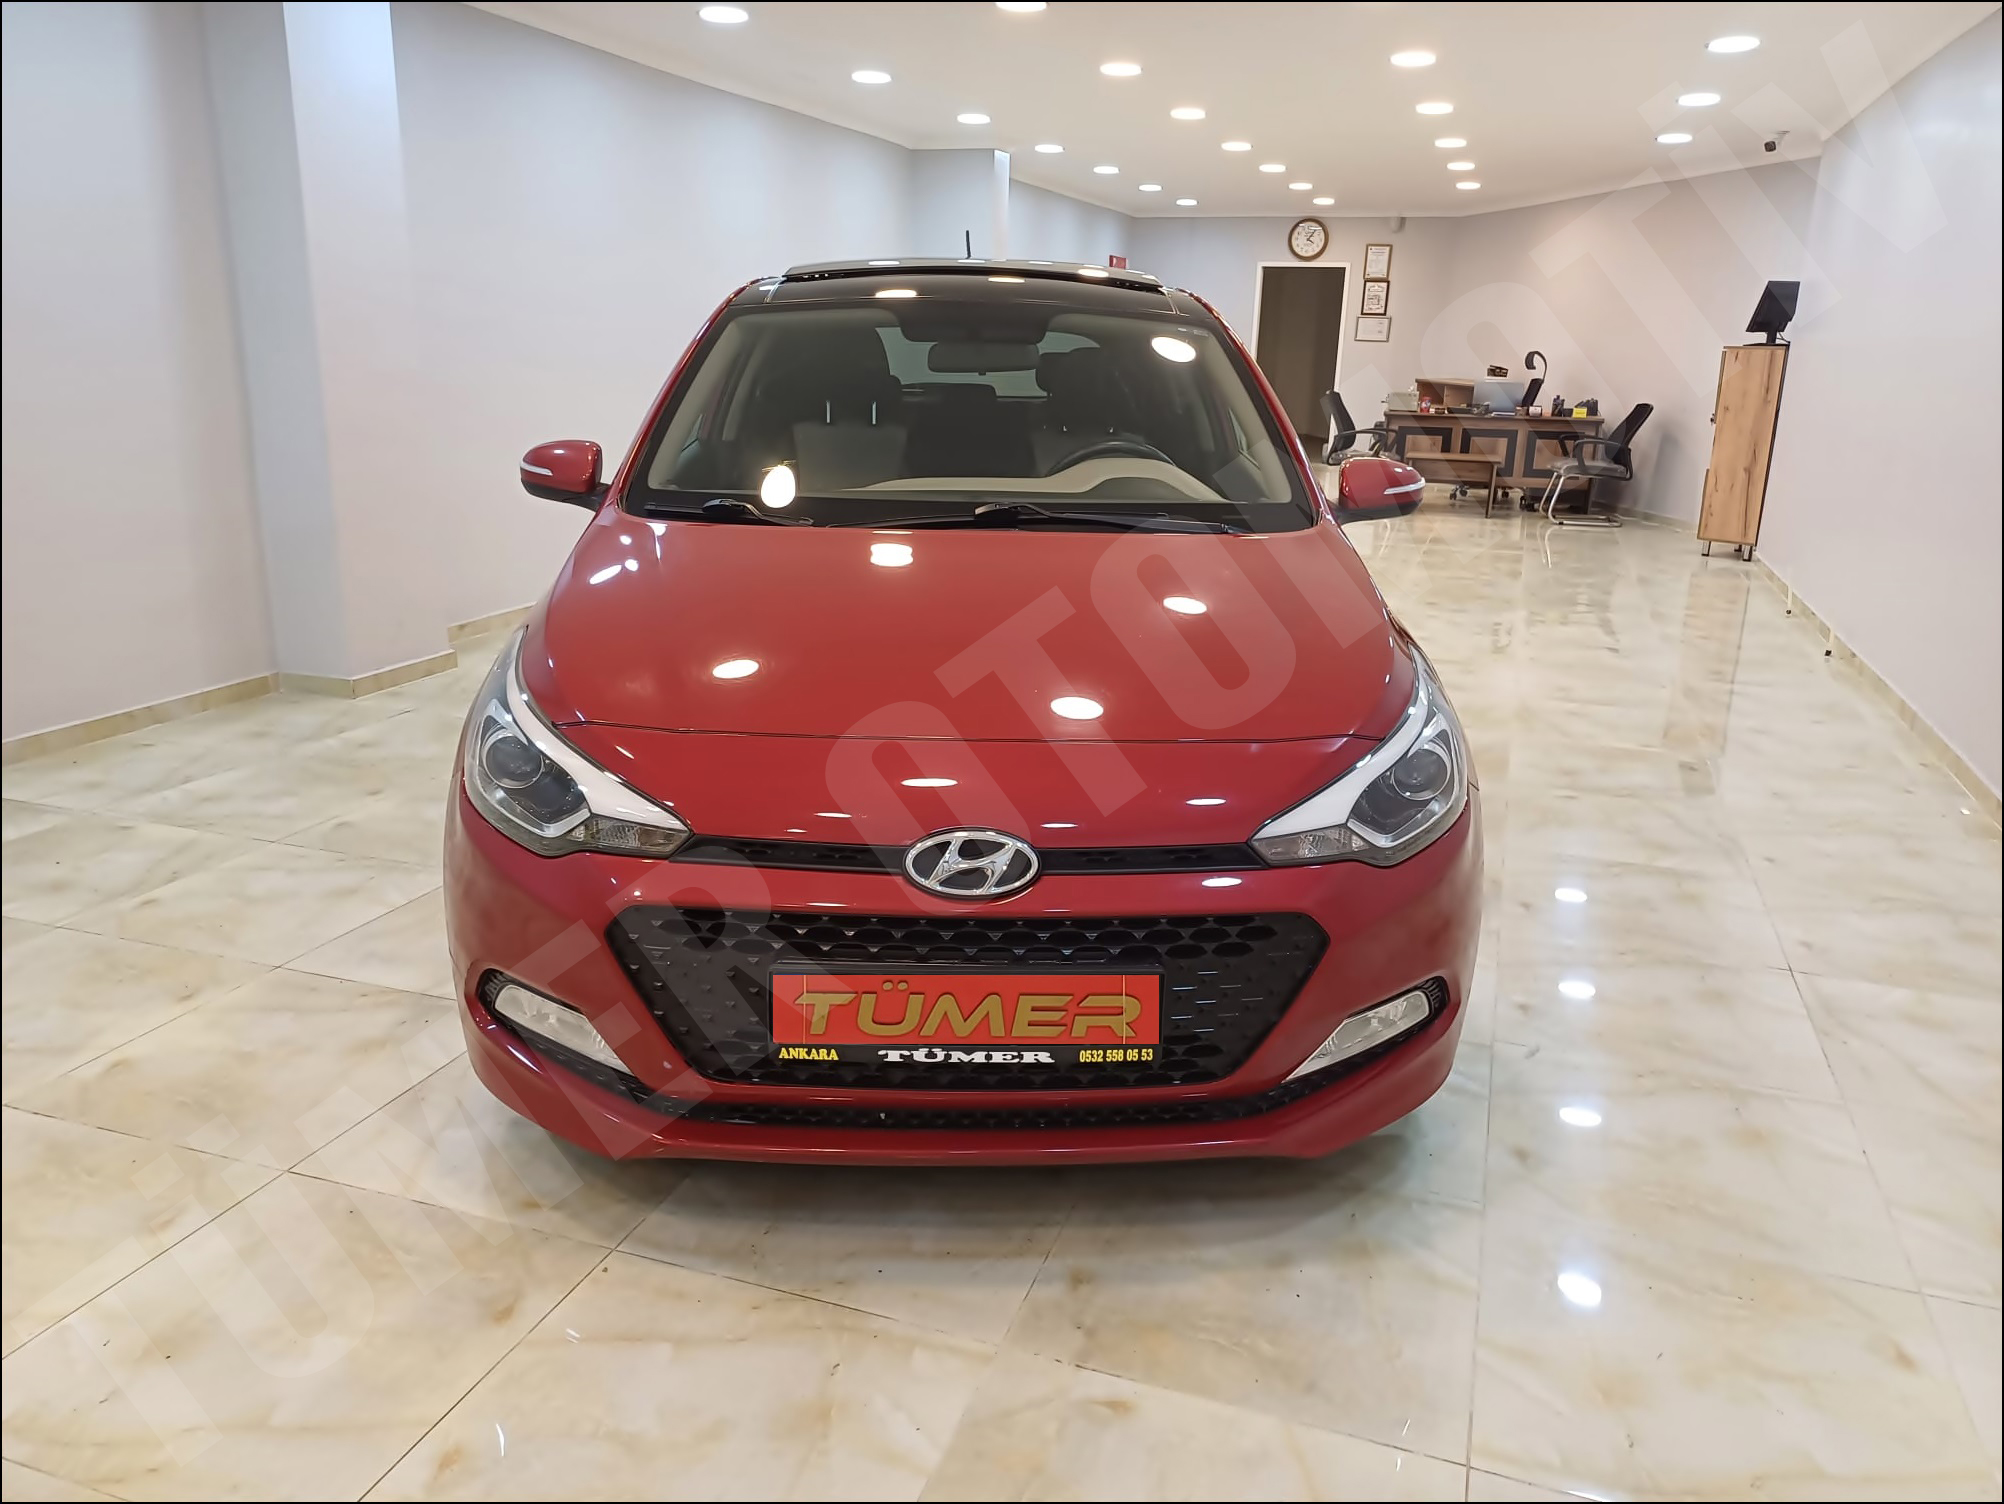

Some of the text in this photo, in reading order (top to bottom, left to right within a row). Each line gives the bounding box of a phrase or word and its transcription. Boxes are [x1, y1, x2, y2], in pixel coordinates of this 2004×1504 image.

[795, 981, 1142, 1038] TÜMER
[778, 1047, 839, 1061] ANKARA
[877, 1048, 1056, 1064] TÜMER
[1079, 1048, 1153, 1063] 0532 558 05 53
